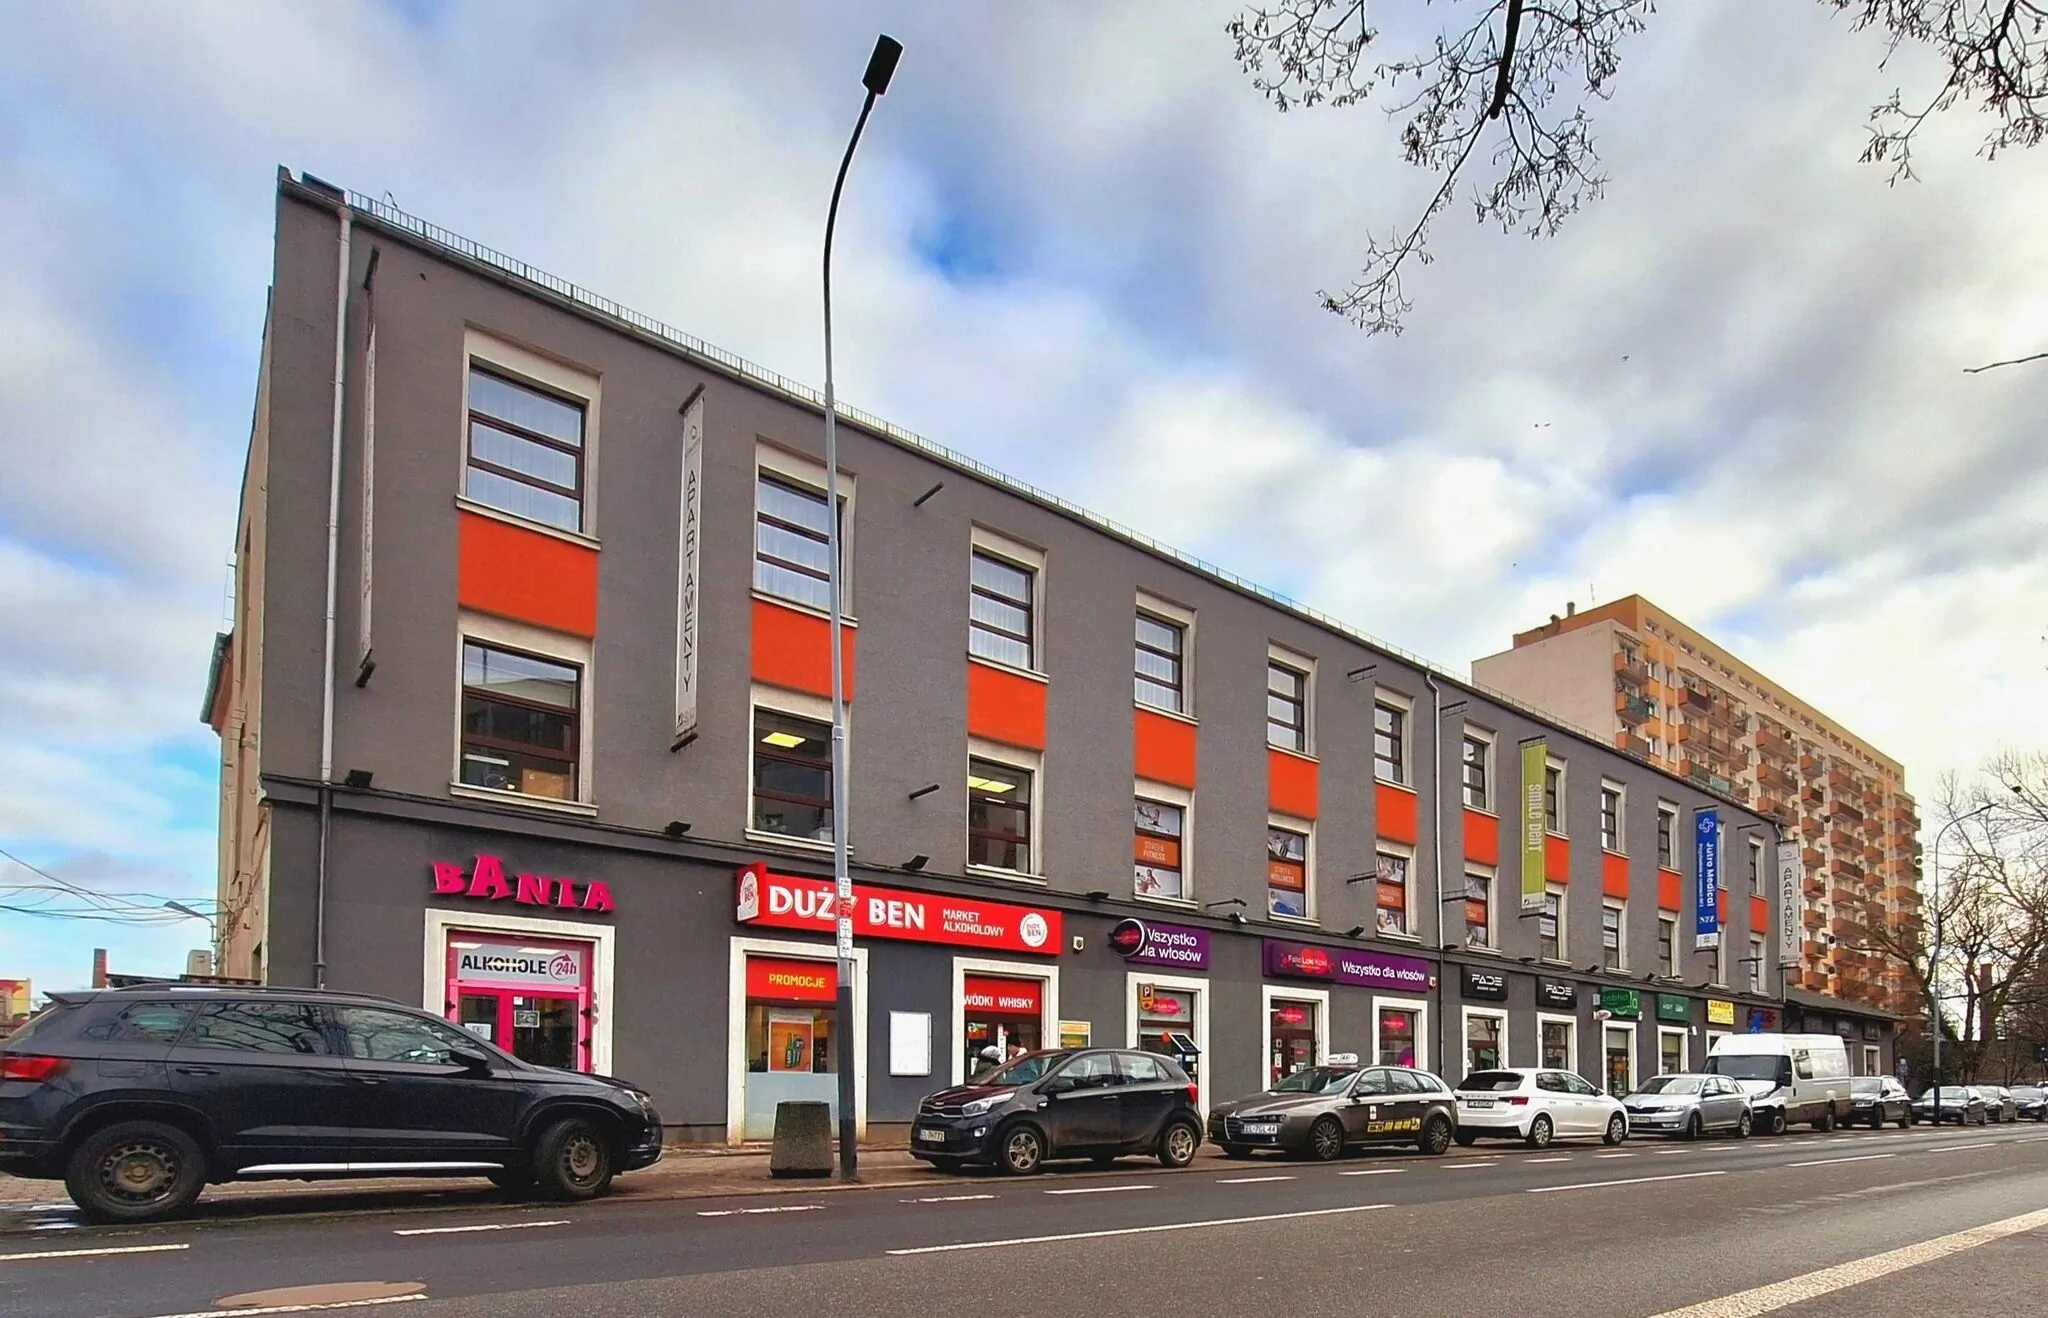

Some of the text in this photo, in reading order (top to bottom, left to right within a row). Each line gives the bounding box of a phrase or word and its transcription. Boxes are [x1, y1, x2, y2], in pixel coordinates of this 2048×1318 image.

[683, 469, 696, 692] APARTAMENTY
[431, 854, 616, 912] BANIA
[1706, 842, 1715, 907] Jutro Medical
[868, 897, 925, 931] BEN
[943, 908, 980, 922] MARKET
[1783, 867, 1793, 949] APARTAMENTY
[943, 920, 1005, 937] ALKOHOLOWY
[1027, 929, 1042, 937] BEN
[1159, 946, 1202, 962] włosów
[461, 954, 577, 976] ALKOHOLE 24h
[1342, 960, 1425, 982] Wszystko dla włosów
[768, 973, 826, 989] PROMOCJE
[1471, 973, 1503, 987] FADE
[1545, 983, 1573, 996] FADE
[964, 993, 1034, 1009] WÓDKI WHISKY
